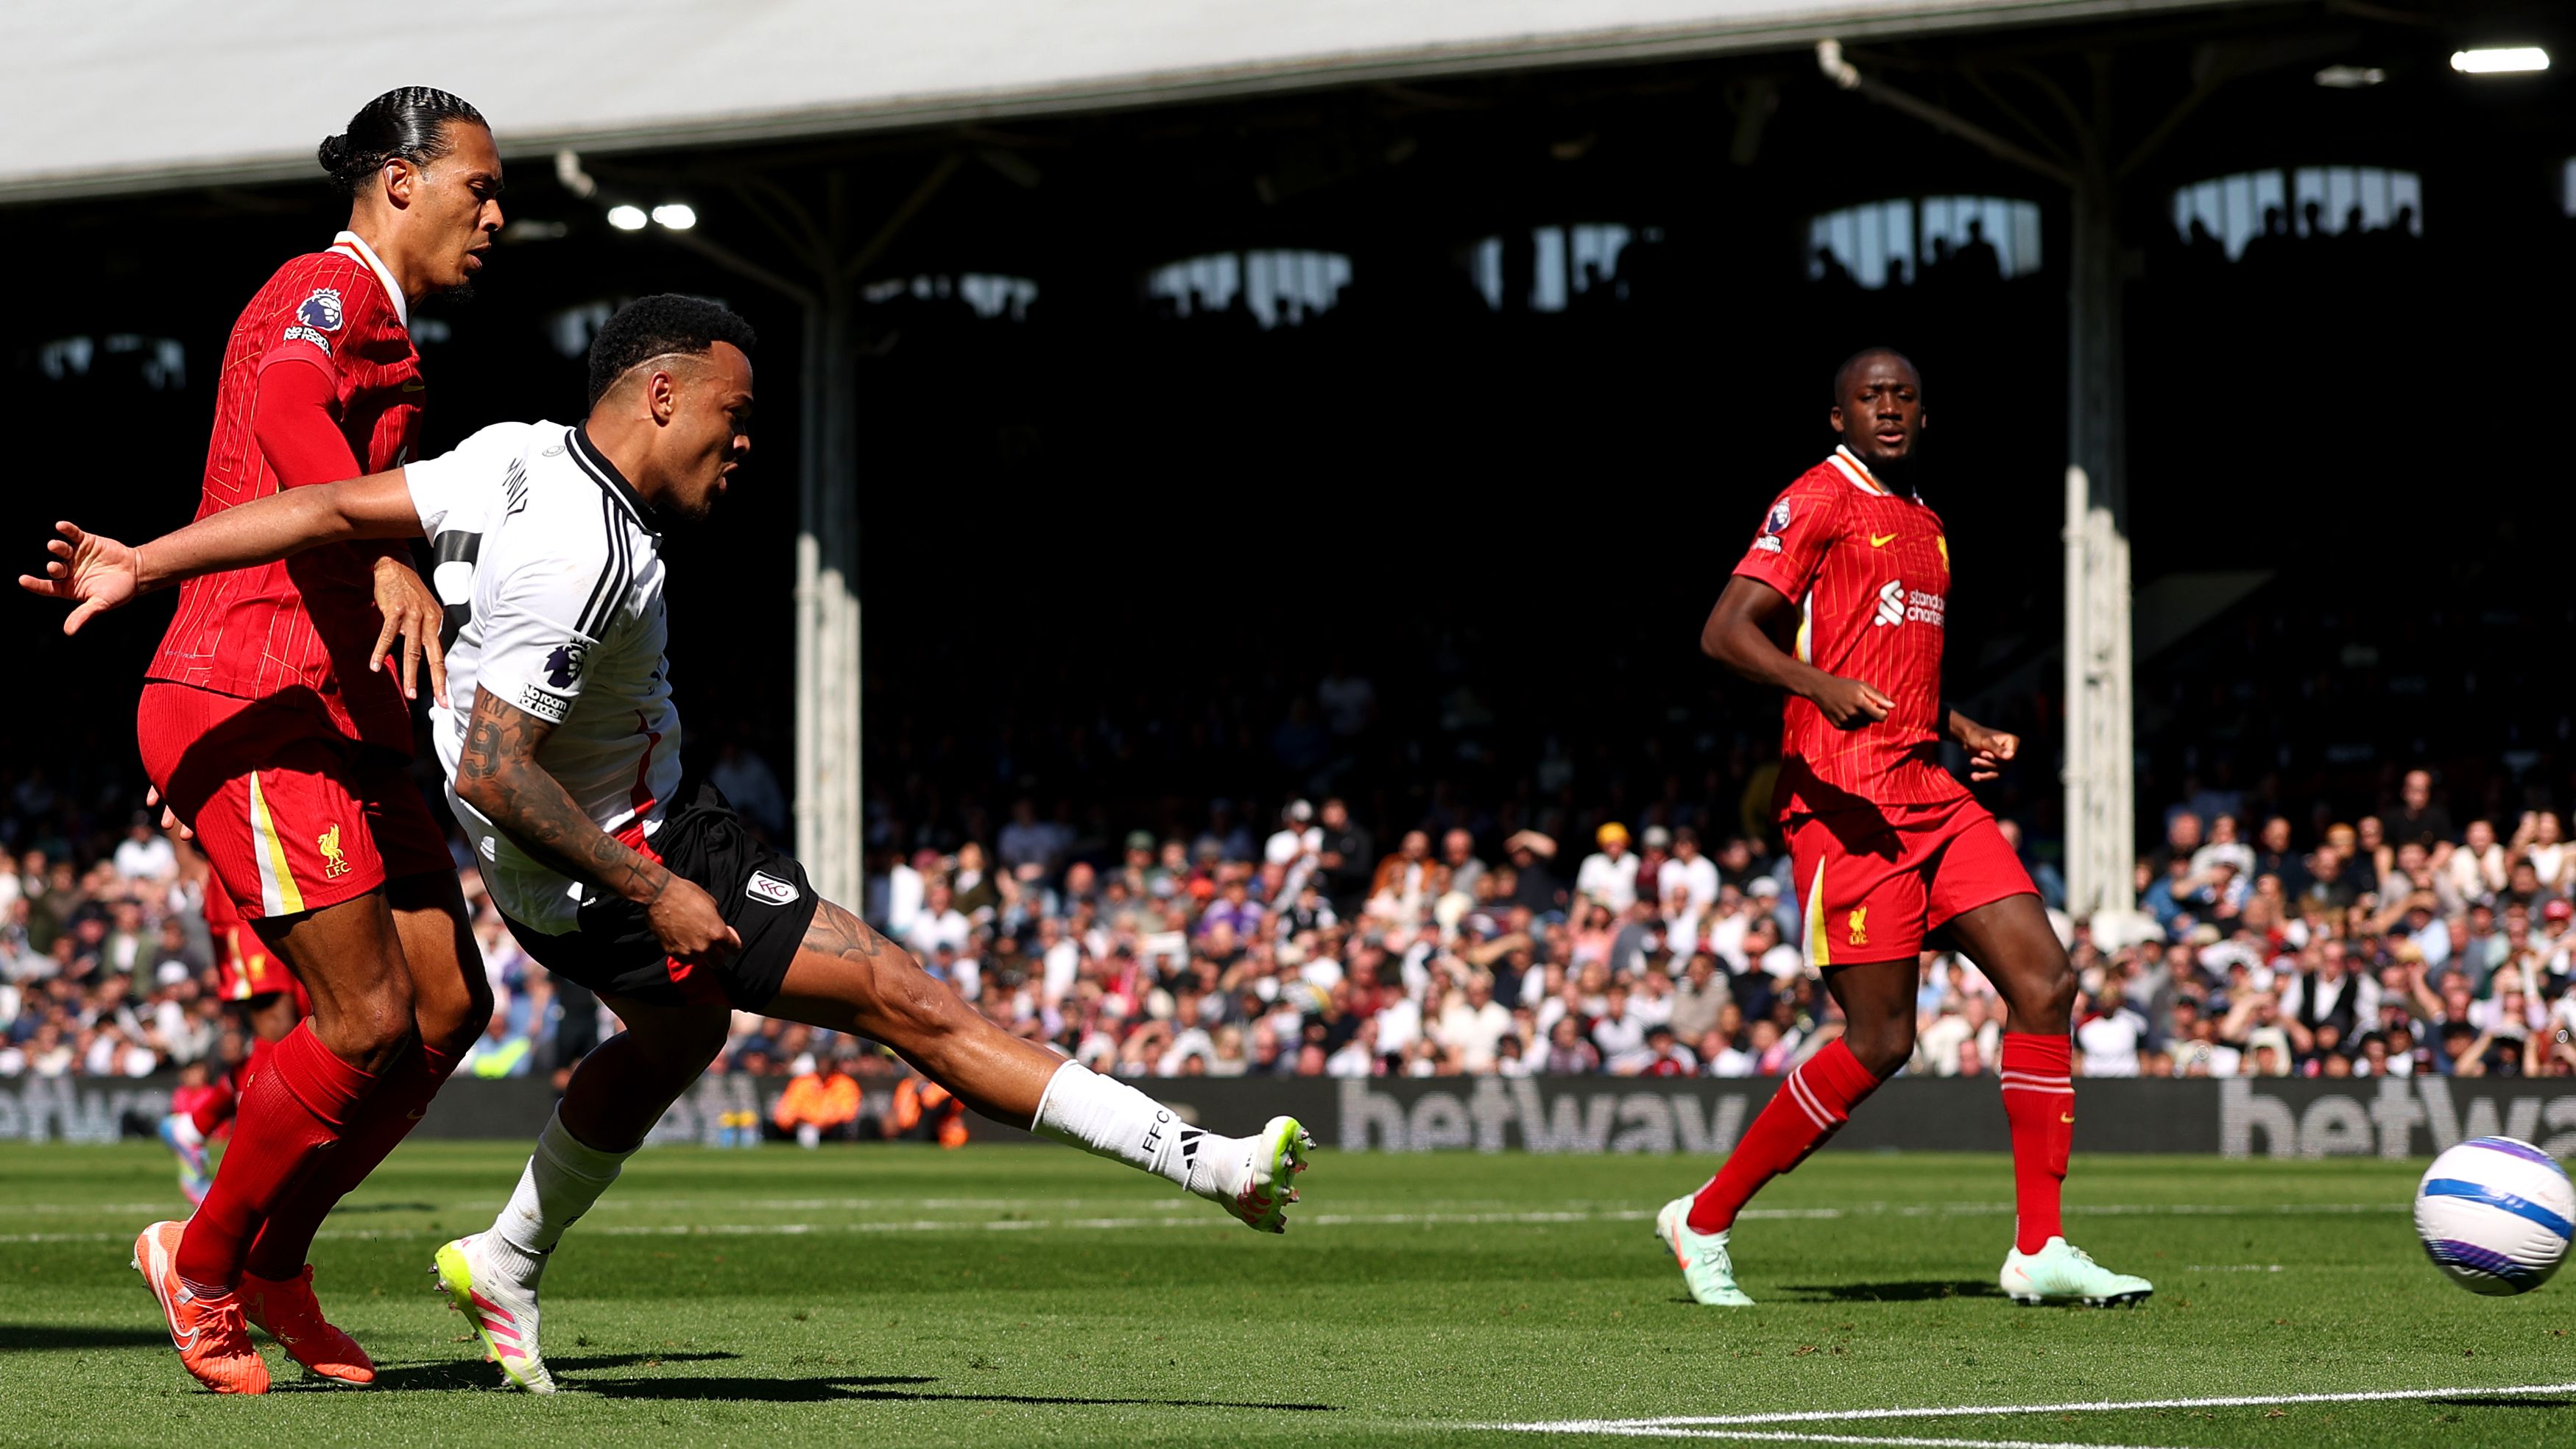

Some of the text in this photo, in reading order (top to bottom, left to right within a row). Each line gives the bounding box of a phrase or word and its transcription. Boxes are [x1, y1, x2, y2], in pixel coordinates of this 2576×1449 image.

[283, 333, 301, 341] for
[285, 326, 329, 350] No room
[1908, 589, 1946, 611] standa
[518, 693, 537, 708] for
[521, 683, 567, 711] No room
[758, 879, 788, 897] FFC
[1141, 1110, 1170, 1153] FFC
